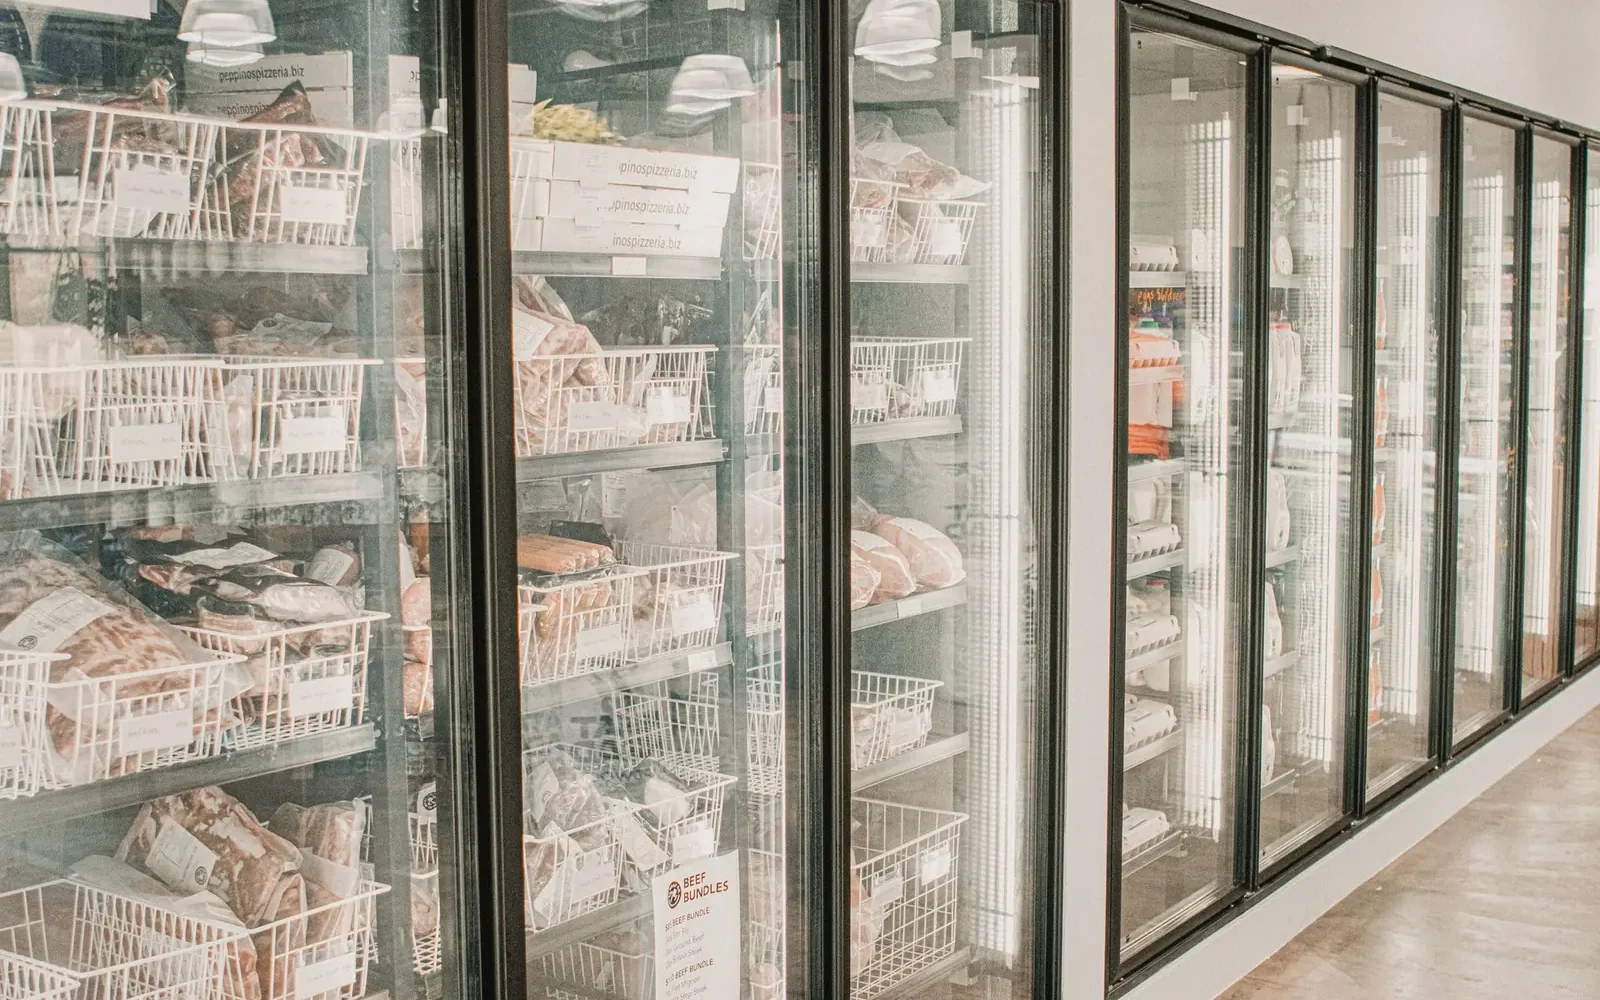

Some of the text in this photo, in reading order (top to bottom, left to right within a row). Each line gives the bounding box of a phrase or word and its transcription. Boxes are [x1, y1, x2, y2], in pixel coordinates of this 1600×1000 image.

[219, 65, 304, 83] peppinospizzeria.biz
[619, 160, 697, 179] pinospizzeria.biz
[683, 871, 706, 889] BEEF
[683, 880, 728, 903] BUNDLES
[672, 914, 686, 928] BEEF
[687, 906, 710, 921] BUNDLE
[675, 966, 689, 980] BEEF
[690, 958, 714, 973] BUNDLE
